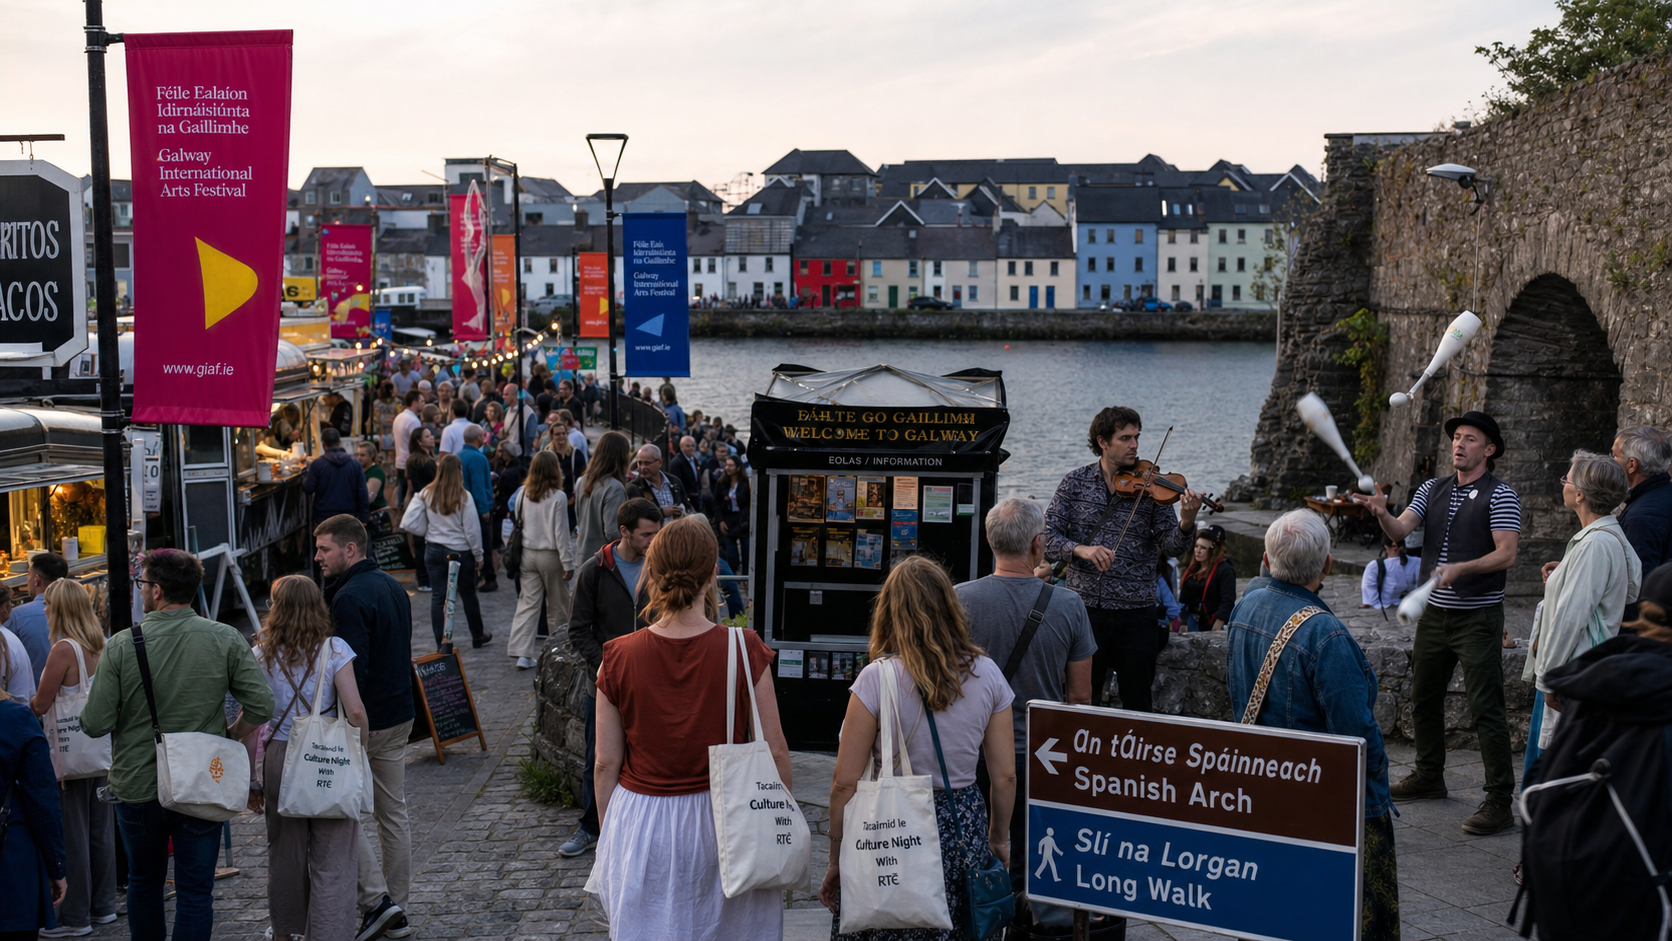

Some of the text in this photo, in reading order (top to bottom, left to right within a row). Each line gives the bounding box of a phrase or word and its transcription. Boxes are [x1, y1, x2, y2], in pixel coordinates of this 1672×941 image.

[156, 86, 248, 100] Féile Ealaíon
[157, 102, 250, 117] Idirnáisiúnta
[158, 120, 249, 134] na Gaillimhe
[158, 148, 212, 165] Galway
[159, 166, 253, 180] International
[160, 183, 246, 197] Arts Festival
[163, 362, 234, 378] www.giaf.ie
[862, 412, 887, 423] GO
[782, 426, 979, 442] WELCOME TO GALWAY
[828, 456, 942, 466] EOLAS / INFORMATION
[304, 753, 330, 764] Culture
[1186, 742, 1322, 784] Spáinneach
[1074, 766, 1252, 814] Spanish Arch
[750, 799, 785, 810] Culture
[775, 816, 792, 826] With
[898, 819, 906, 827] le
[856, 835, 922, 850] Culture Night
[876, 856, 898, 867] With
[1074, 828, 1258, 881] Slí na Lorgan
[1077, 864, 1212, 911] Long Walk
